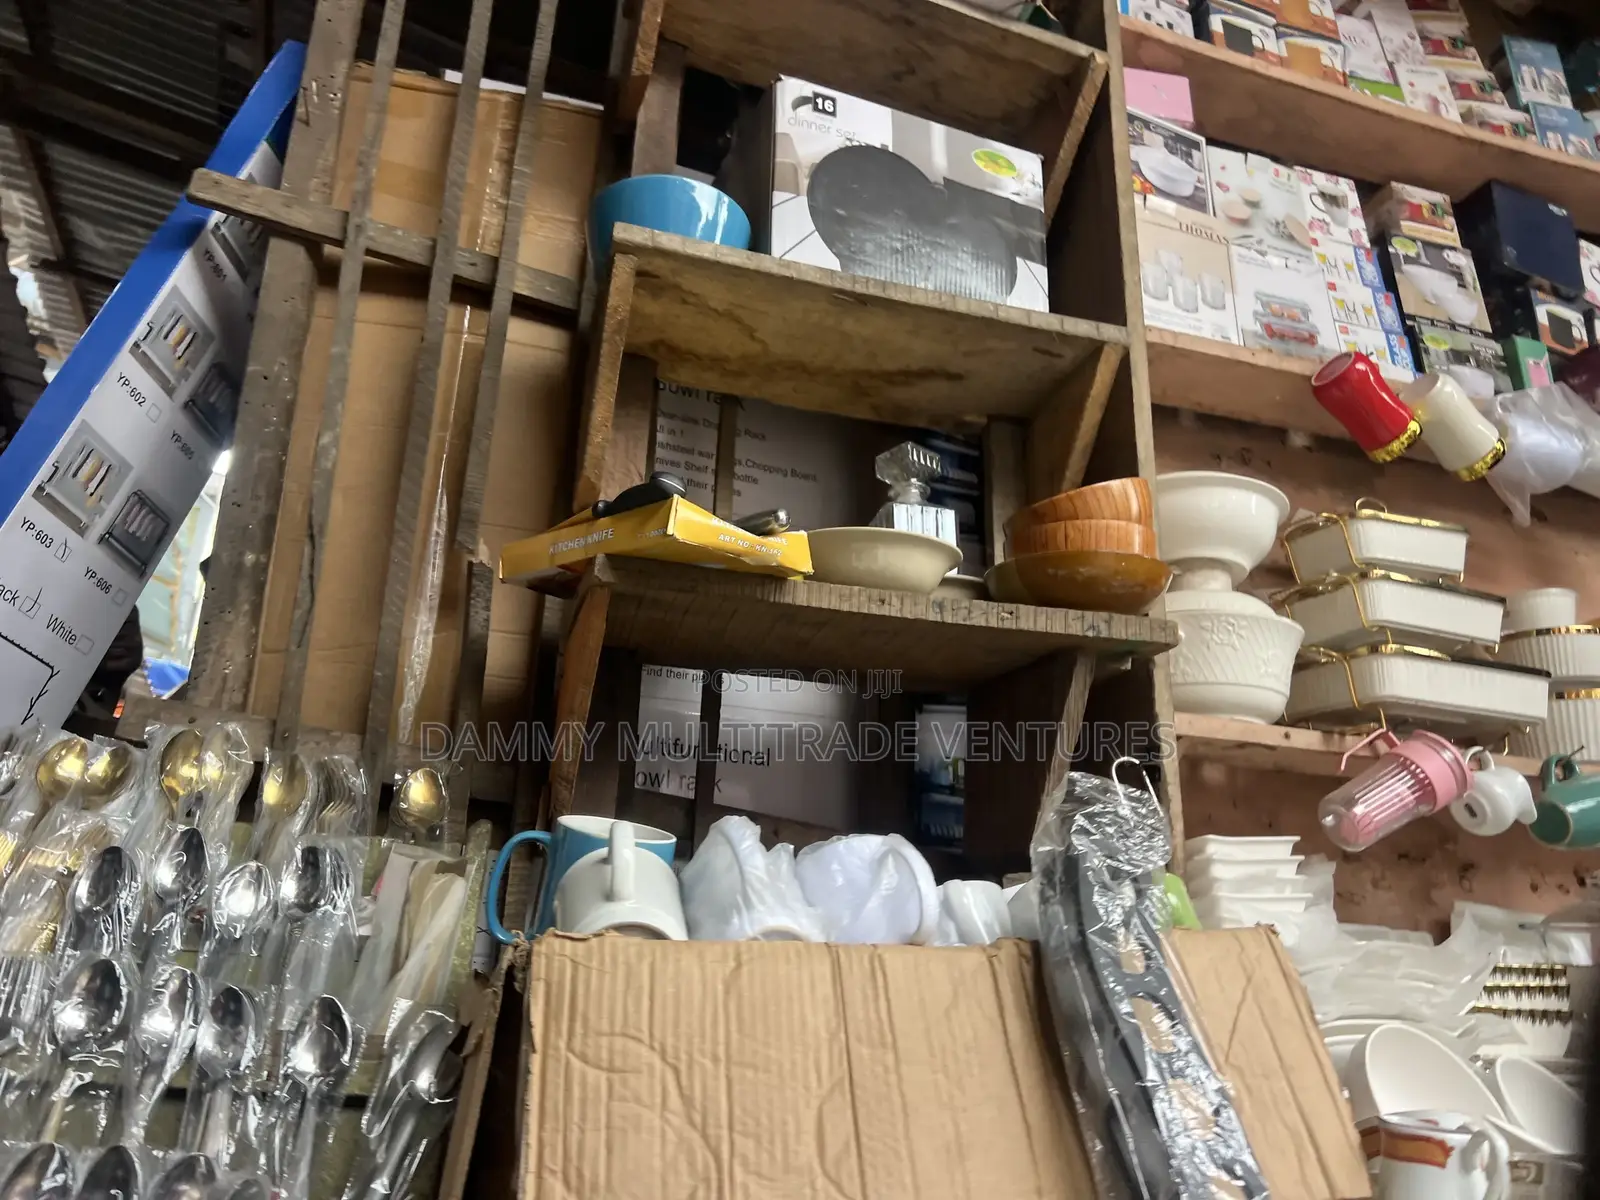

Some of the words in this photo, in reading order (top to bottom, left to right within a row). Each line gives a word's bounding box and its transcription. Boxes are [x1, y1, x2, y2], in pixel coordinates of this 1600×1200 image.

[816, 97, 834, 112] 16
[787, 112, 833, 134] dinner
[116, 371, 147, 407] YP:602
[655, 457, 682, 469] nives
[19, 517, 54, 549] YP:603
[549, 537, 586, 556] KITCHEN
[585, 528, 615, 545] KNIFE
[718, 534, 736, 545] ART
[84, 566, 113, 595] YP:606
[46, 613, 78, 647] White
[666, 668, 690, 680] their
[635, 769, 671, 788] owl
